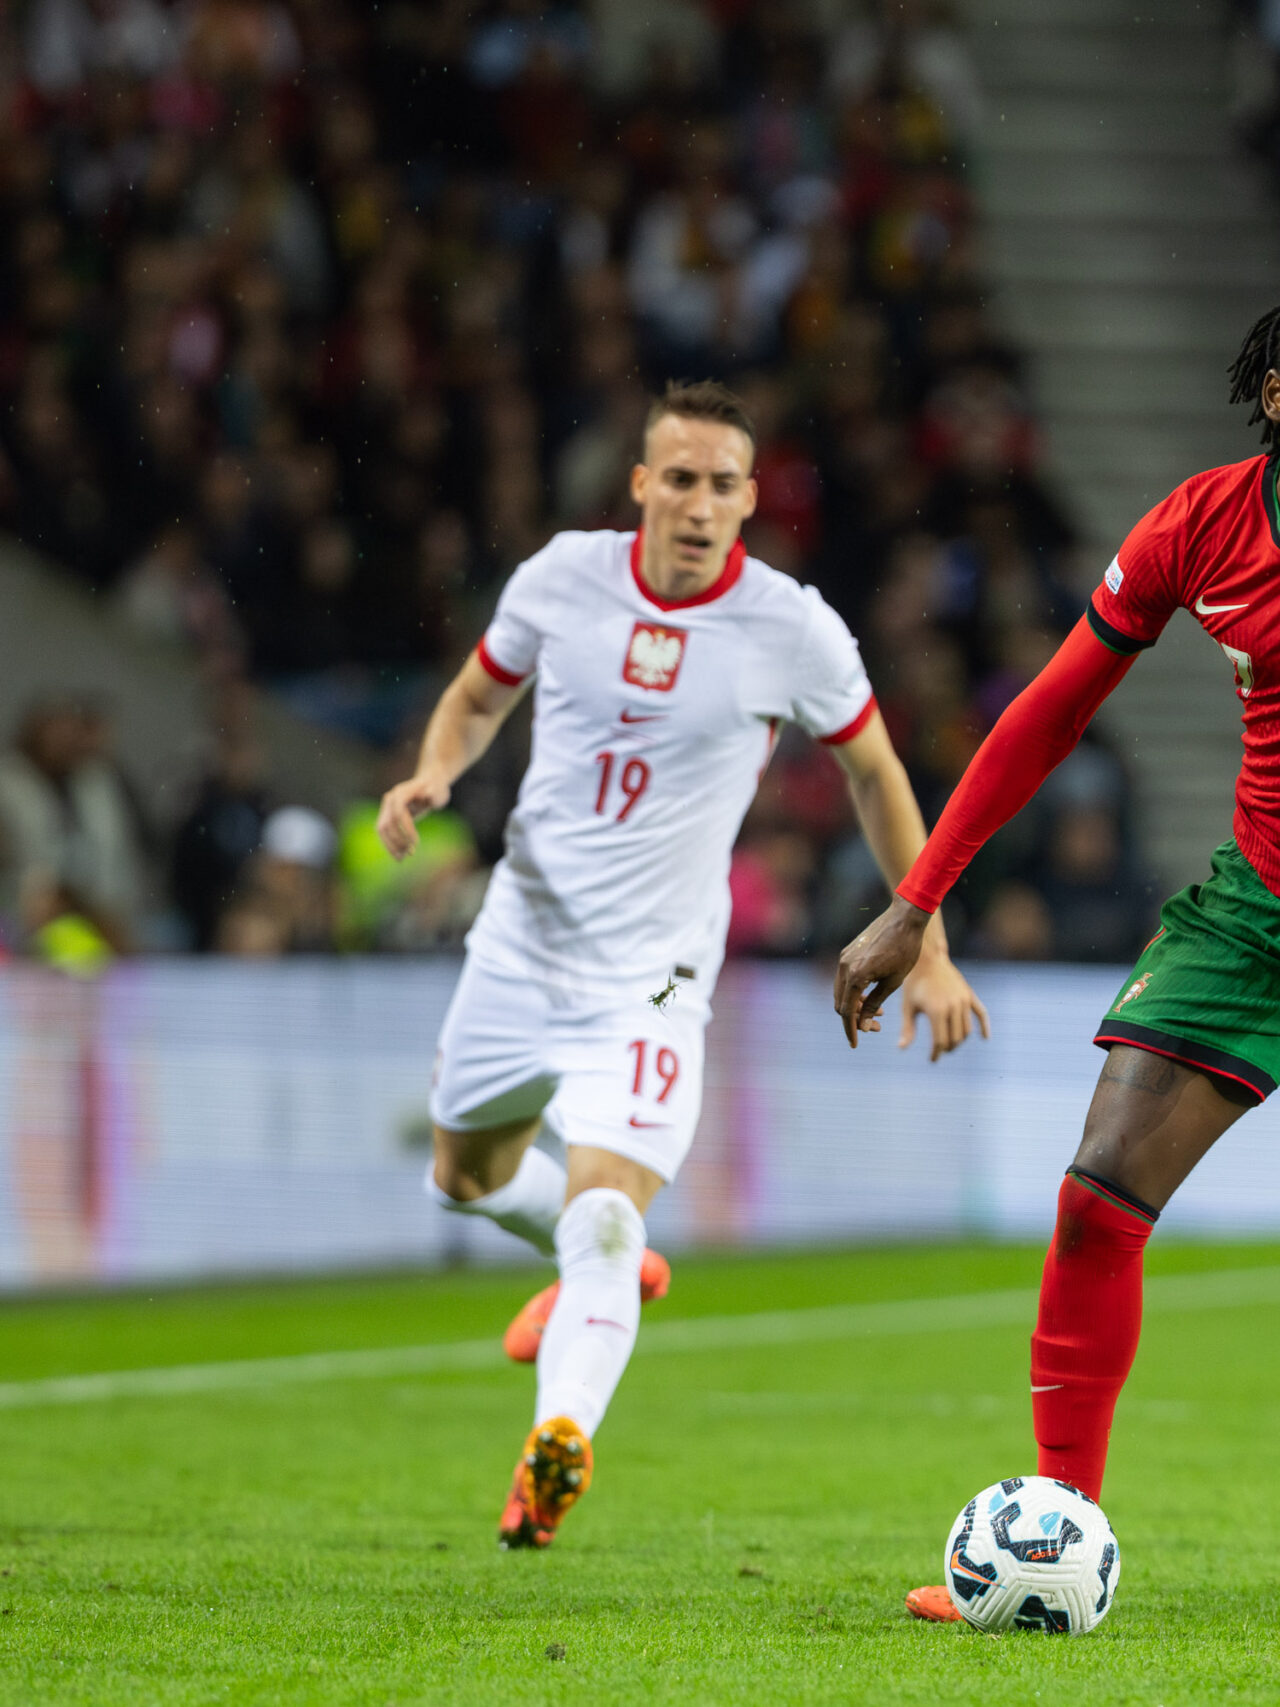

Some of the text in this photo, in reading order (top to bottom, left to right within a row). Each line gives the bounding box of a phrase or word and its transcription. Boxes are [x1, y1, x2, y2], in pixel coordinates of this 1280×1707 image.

[1213, 638, 1254, 698] 7
[595, 750, 651, 823] 19
[627, 1039, 680, 1104] 19
